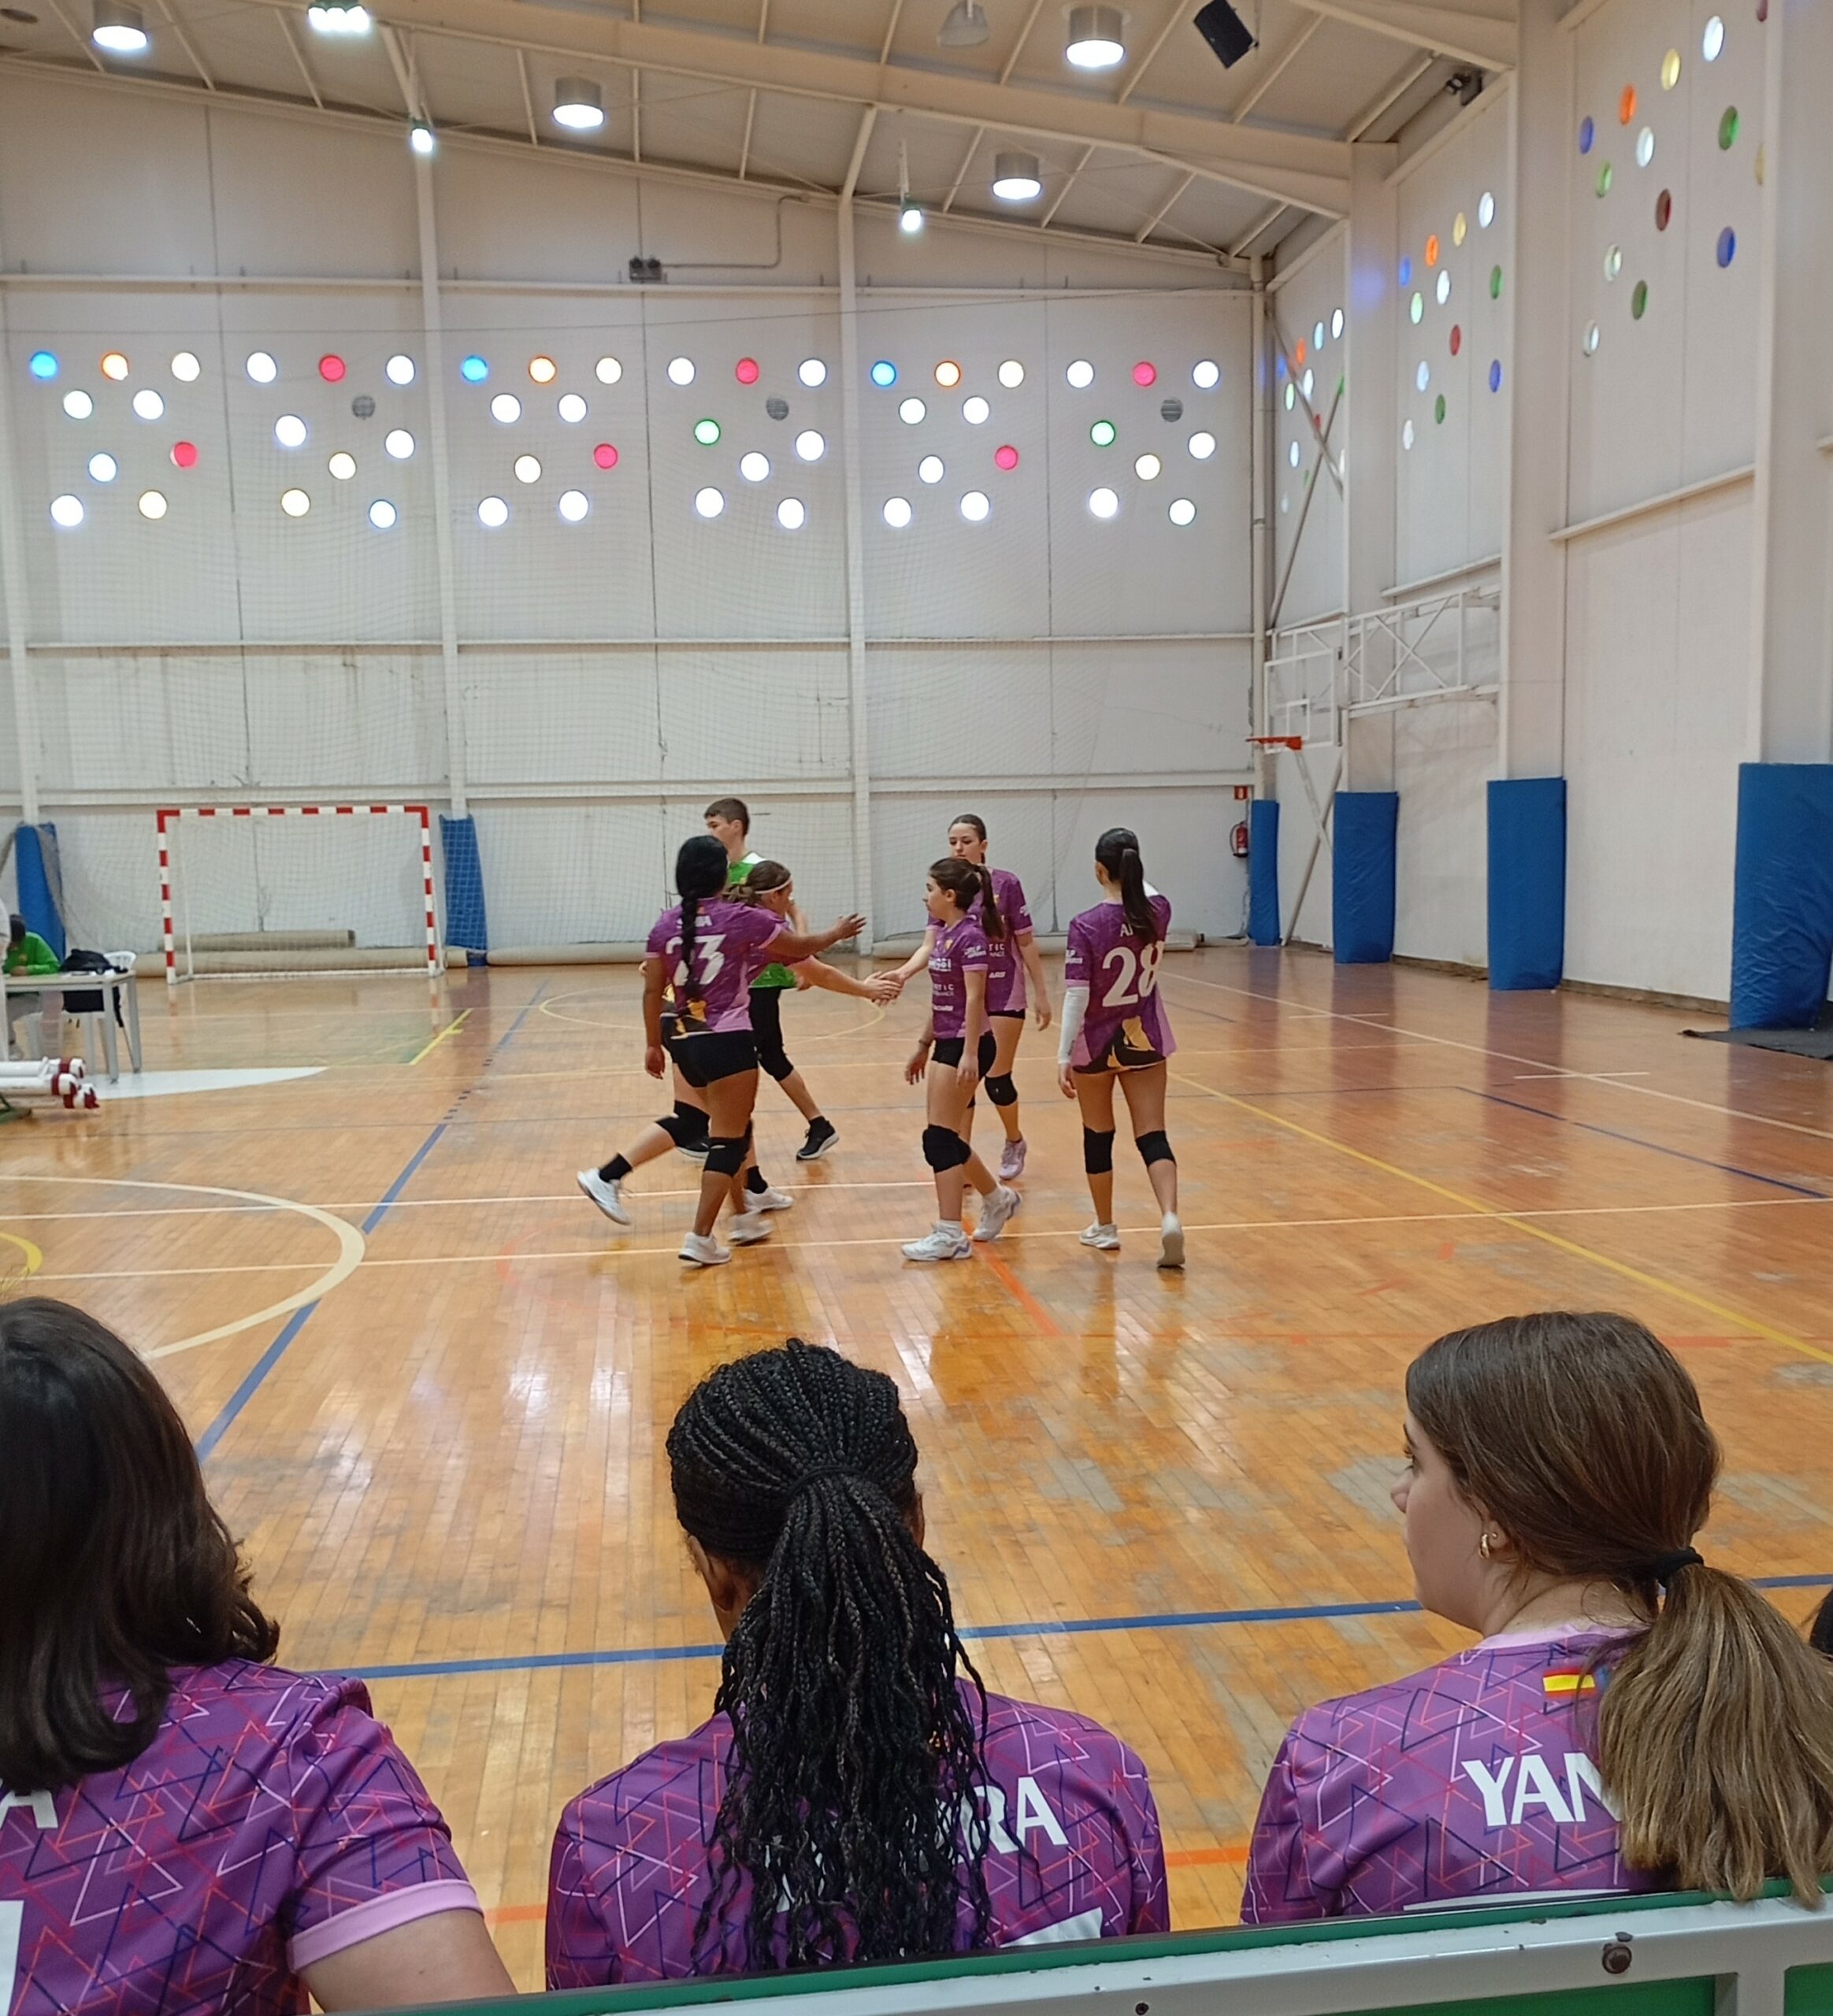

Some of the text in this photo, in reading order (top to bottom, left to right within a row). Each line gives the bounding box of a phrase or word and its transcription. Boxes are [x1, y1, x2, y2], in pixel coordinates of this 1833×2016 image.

[665, 934, 726, 987] 23
[1102, 940, 1165, 1007] 28
[0, 1778, 58, 1829] A
[936, 1776, 1069, 1864] RA
[1461, 1752, 1624, 1827] YAN
